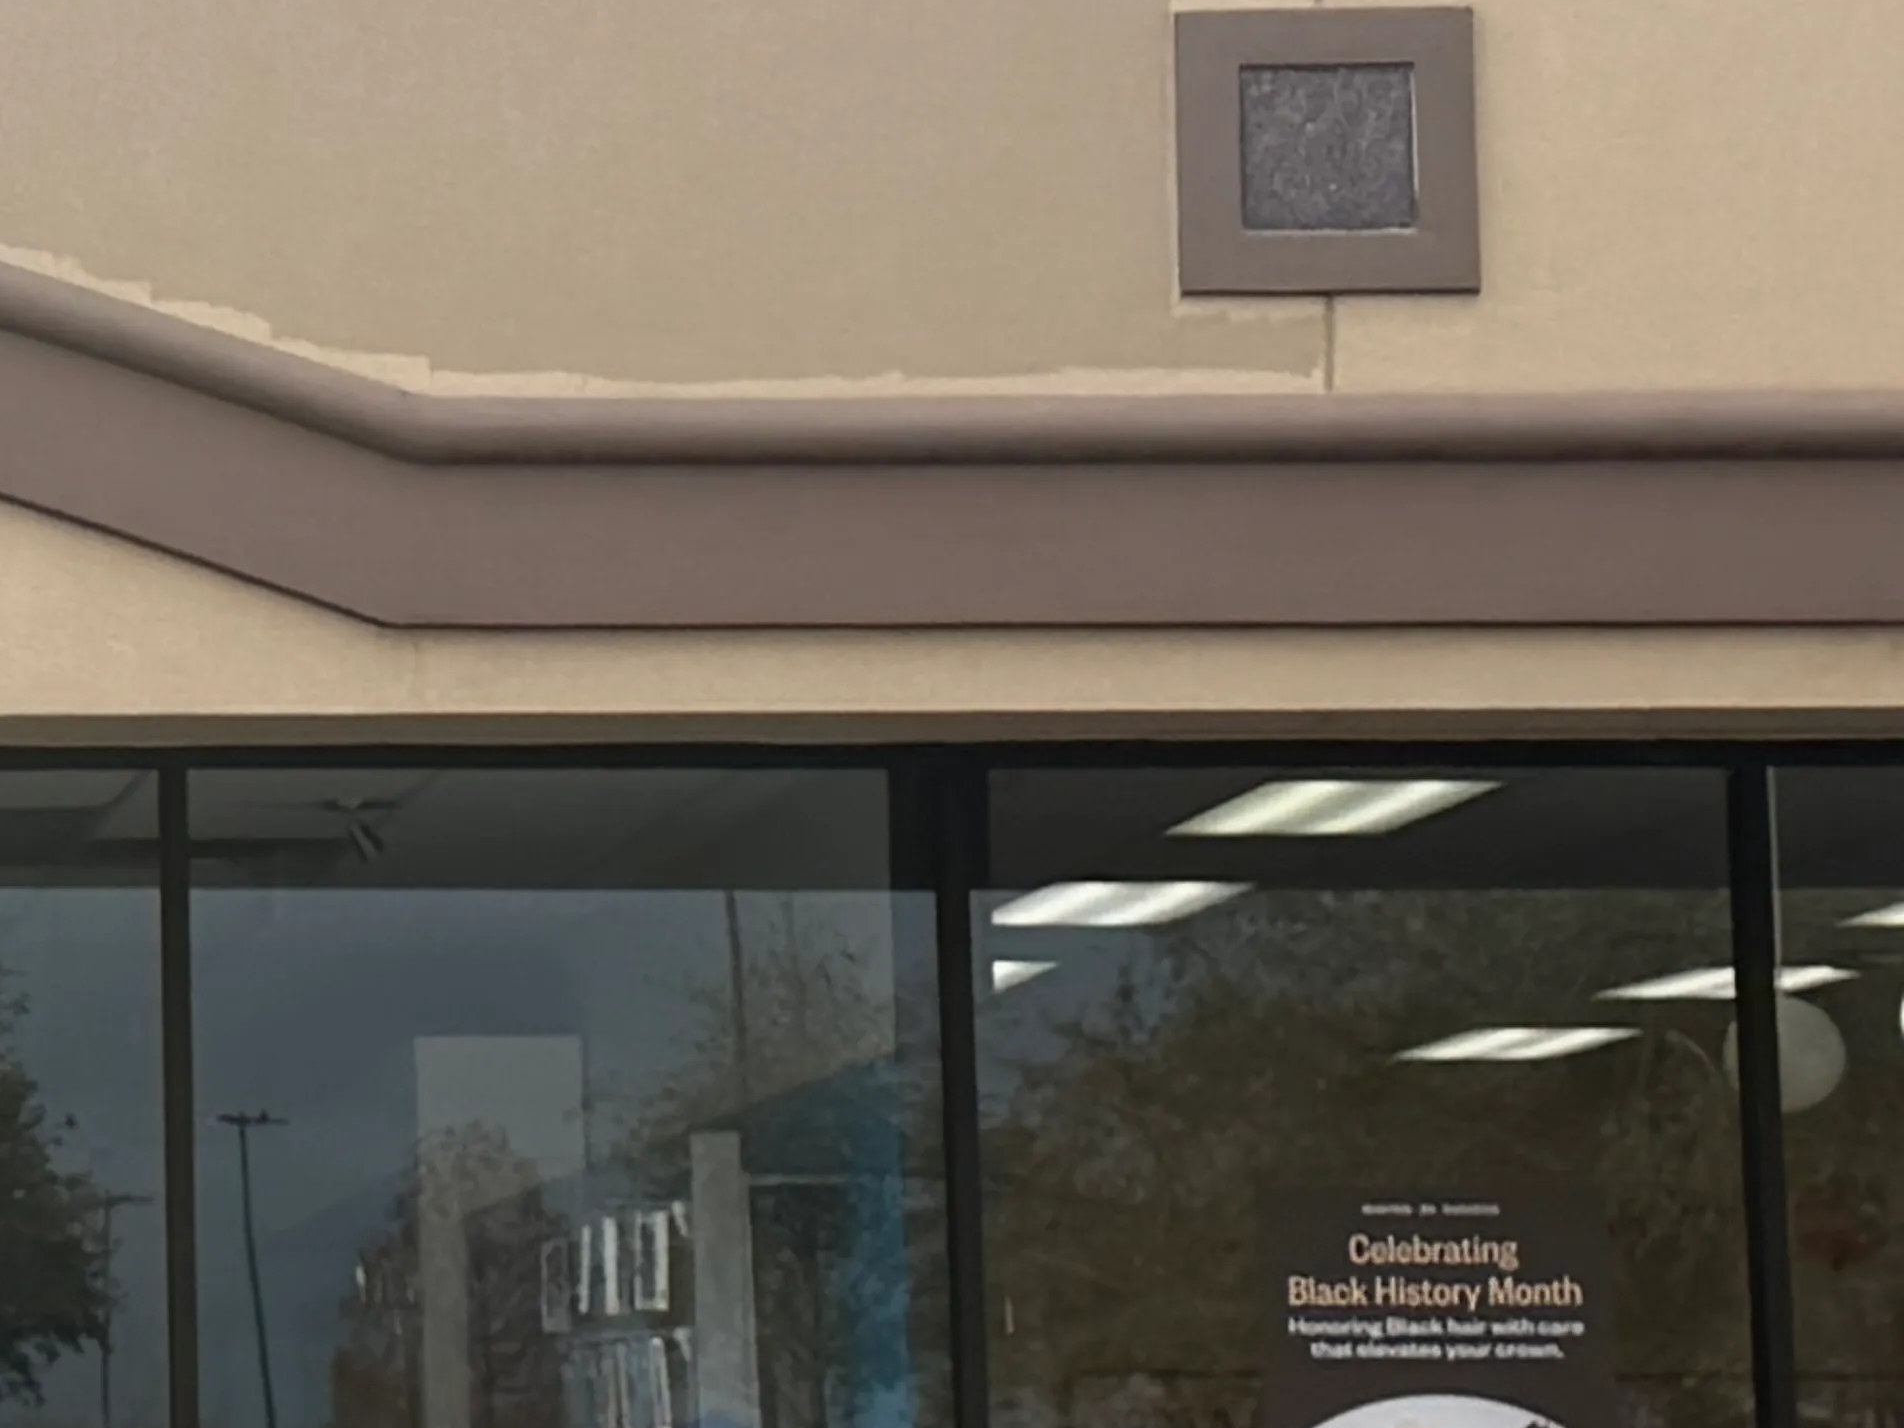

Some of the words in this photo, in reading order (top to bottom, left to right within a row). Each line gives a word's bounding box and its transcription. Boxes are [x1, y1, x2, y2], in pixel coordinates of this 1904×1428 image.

[1348, 1233, 1519, 1271] Celebrating
[1288, 1276, 1367, 1305] Black
[1374, 1276, 1482, 1311] History
[1488, 1275, 1583, 1306] Month
[1288, 1317, 1384, 1339] Honoring
[1386, 1316, 1443, 1336] Black
[1446, 1318, 1486, 1335] hair
[1491, 1317, 1535, 1335] with
[1310, 1342, 1353, 1358] that
[1446, 1344, 1491, 1361] your
